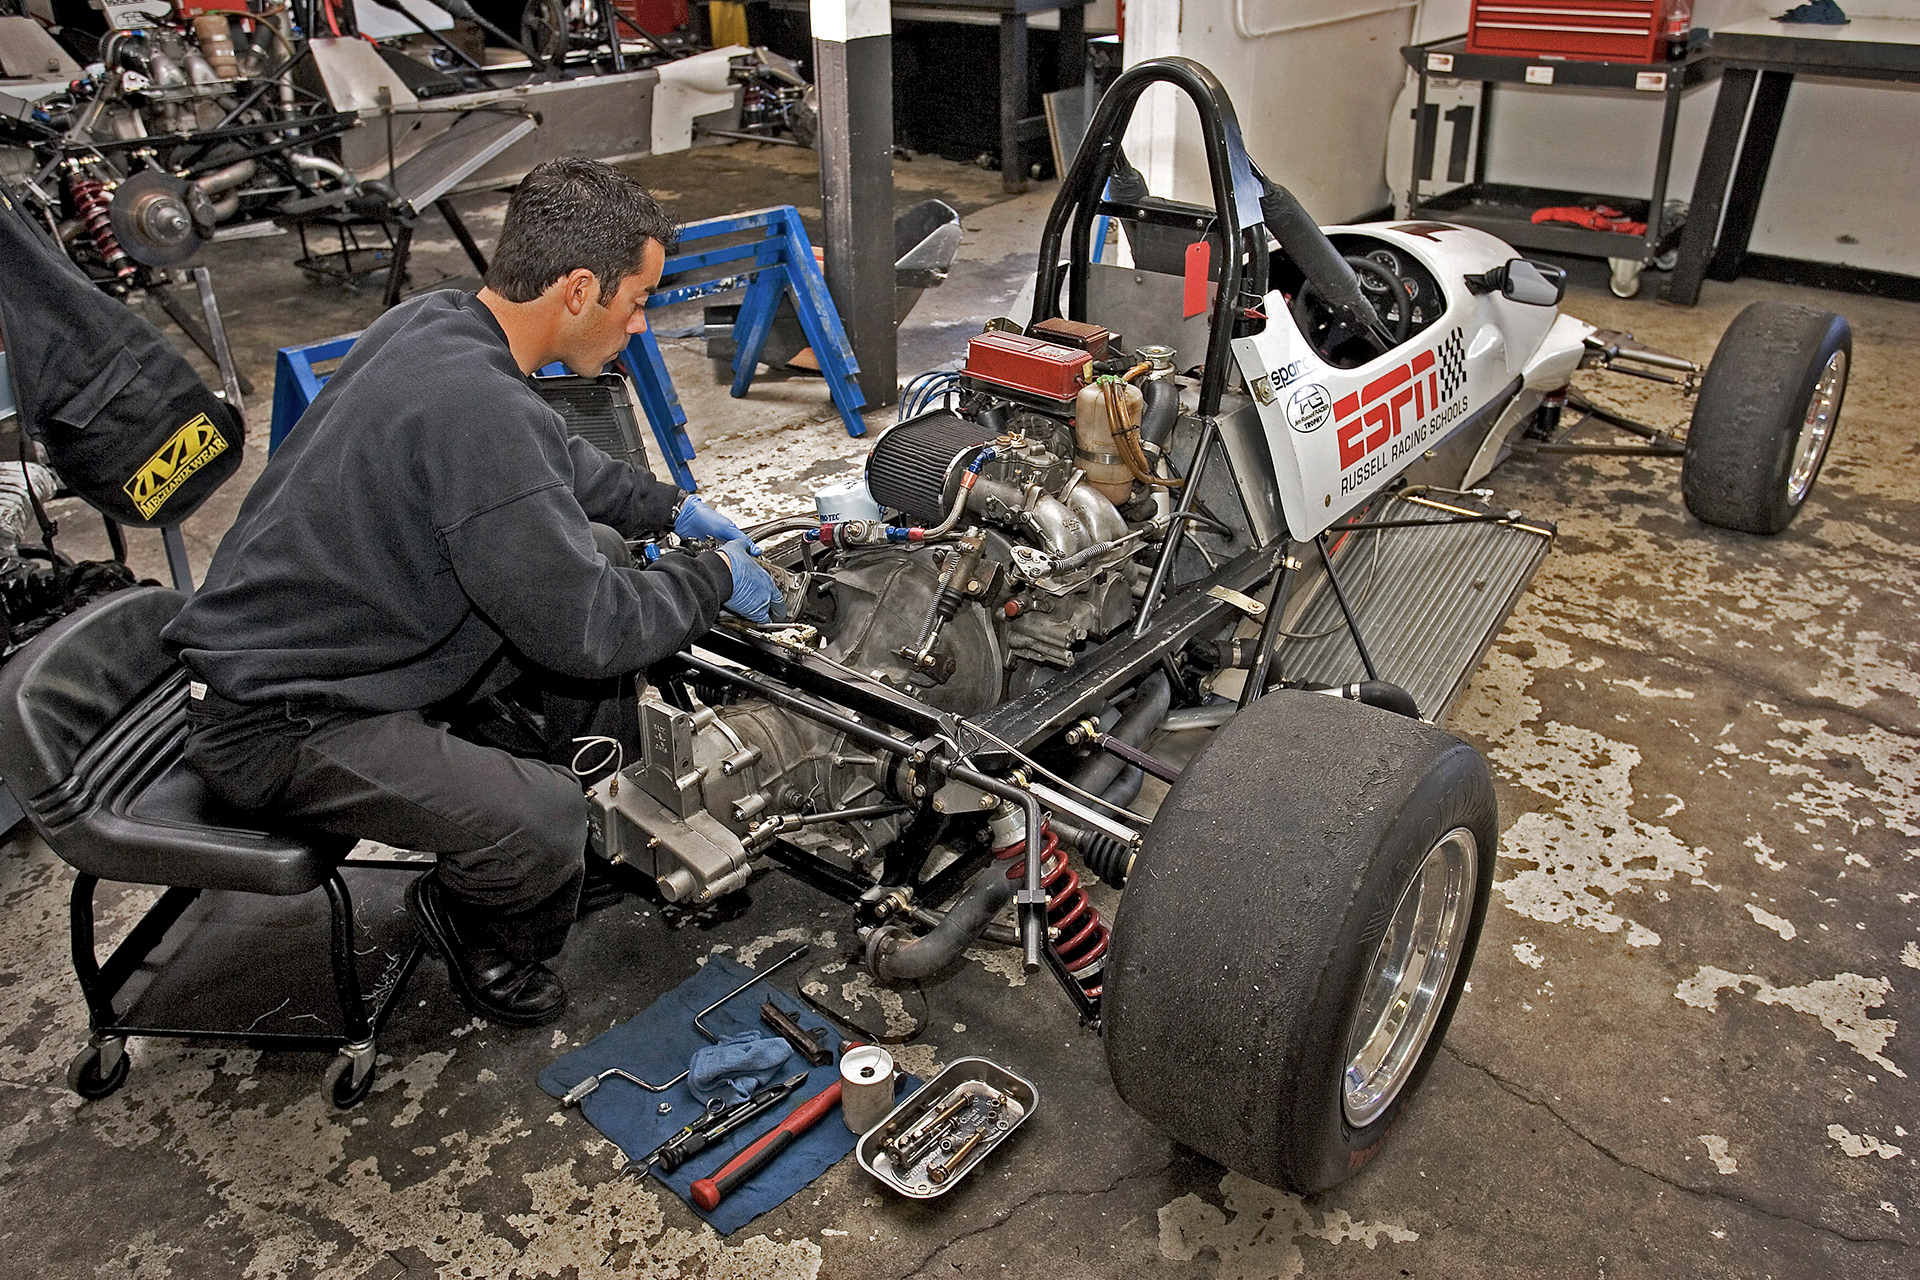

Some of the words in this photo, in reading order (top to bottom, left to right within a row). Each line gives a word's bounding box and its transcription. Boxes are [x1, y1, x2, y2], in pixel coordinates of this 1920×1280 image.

[1304, 415, 1322, 429] TROPHY
[1333, 349, 1439, 472] ESPN
[1341, 452, 1388, 496] RUSSELL
[1391, 425, 1427, 462] RACING
[1430, 396, 1469, 435] SCHOOLS
[140, 463, 194, 516] MECHANIX
[190, 438, 226, 469] WEAR
